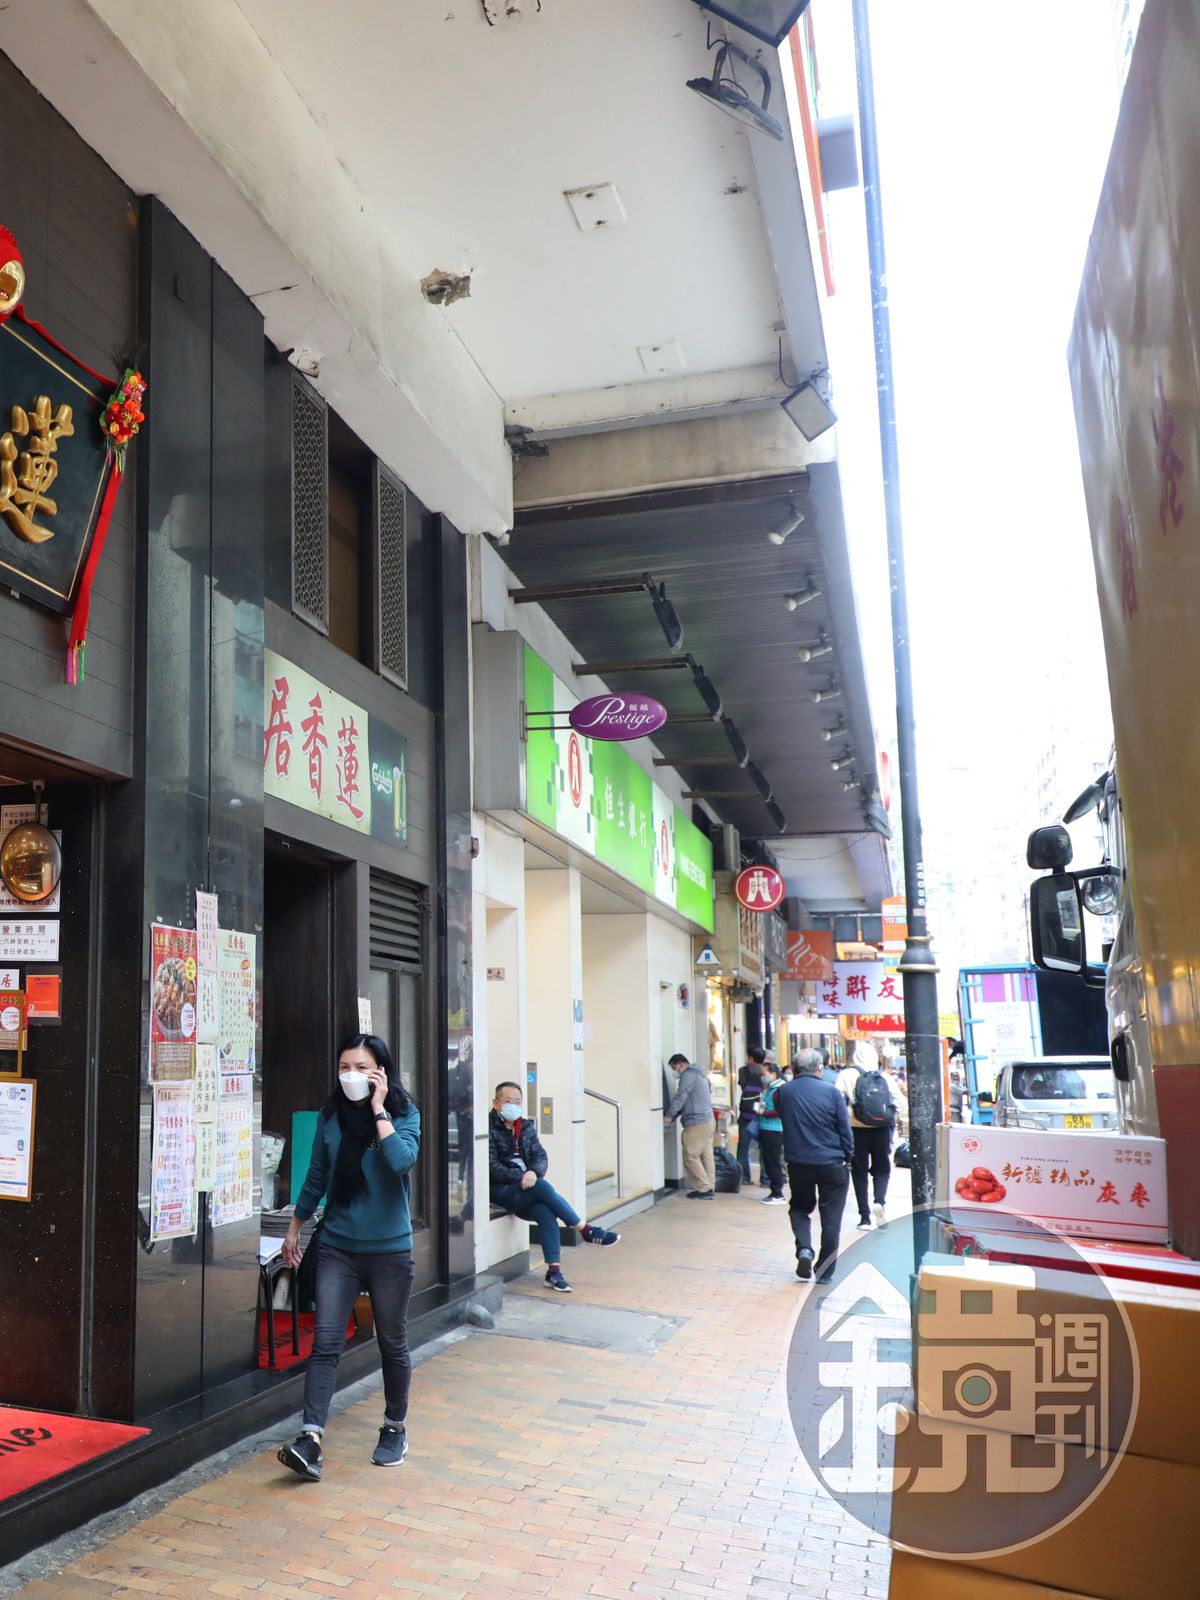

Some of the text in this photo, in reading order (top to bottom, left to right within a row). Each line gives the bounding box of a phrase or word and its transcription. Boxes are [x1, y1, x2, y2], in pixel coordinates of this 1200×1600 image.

[577, 697, 658, 729] Prestige
[2, 925, 46, 934] 營業時間
[1065, 1121, 1091, 1129] 3238
[1096, 1181, 1151, 1208] 灰枣
